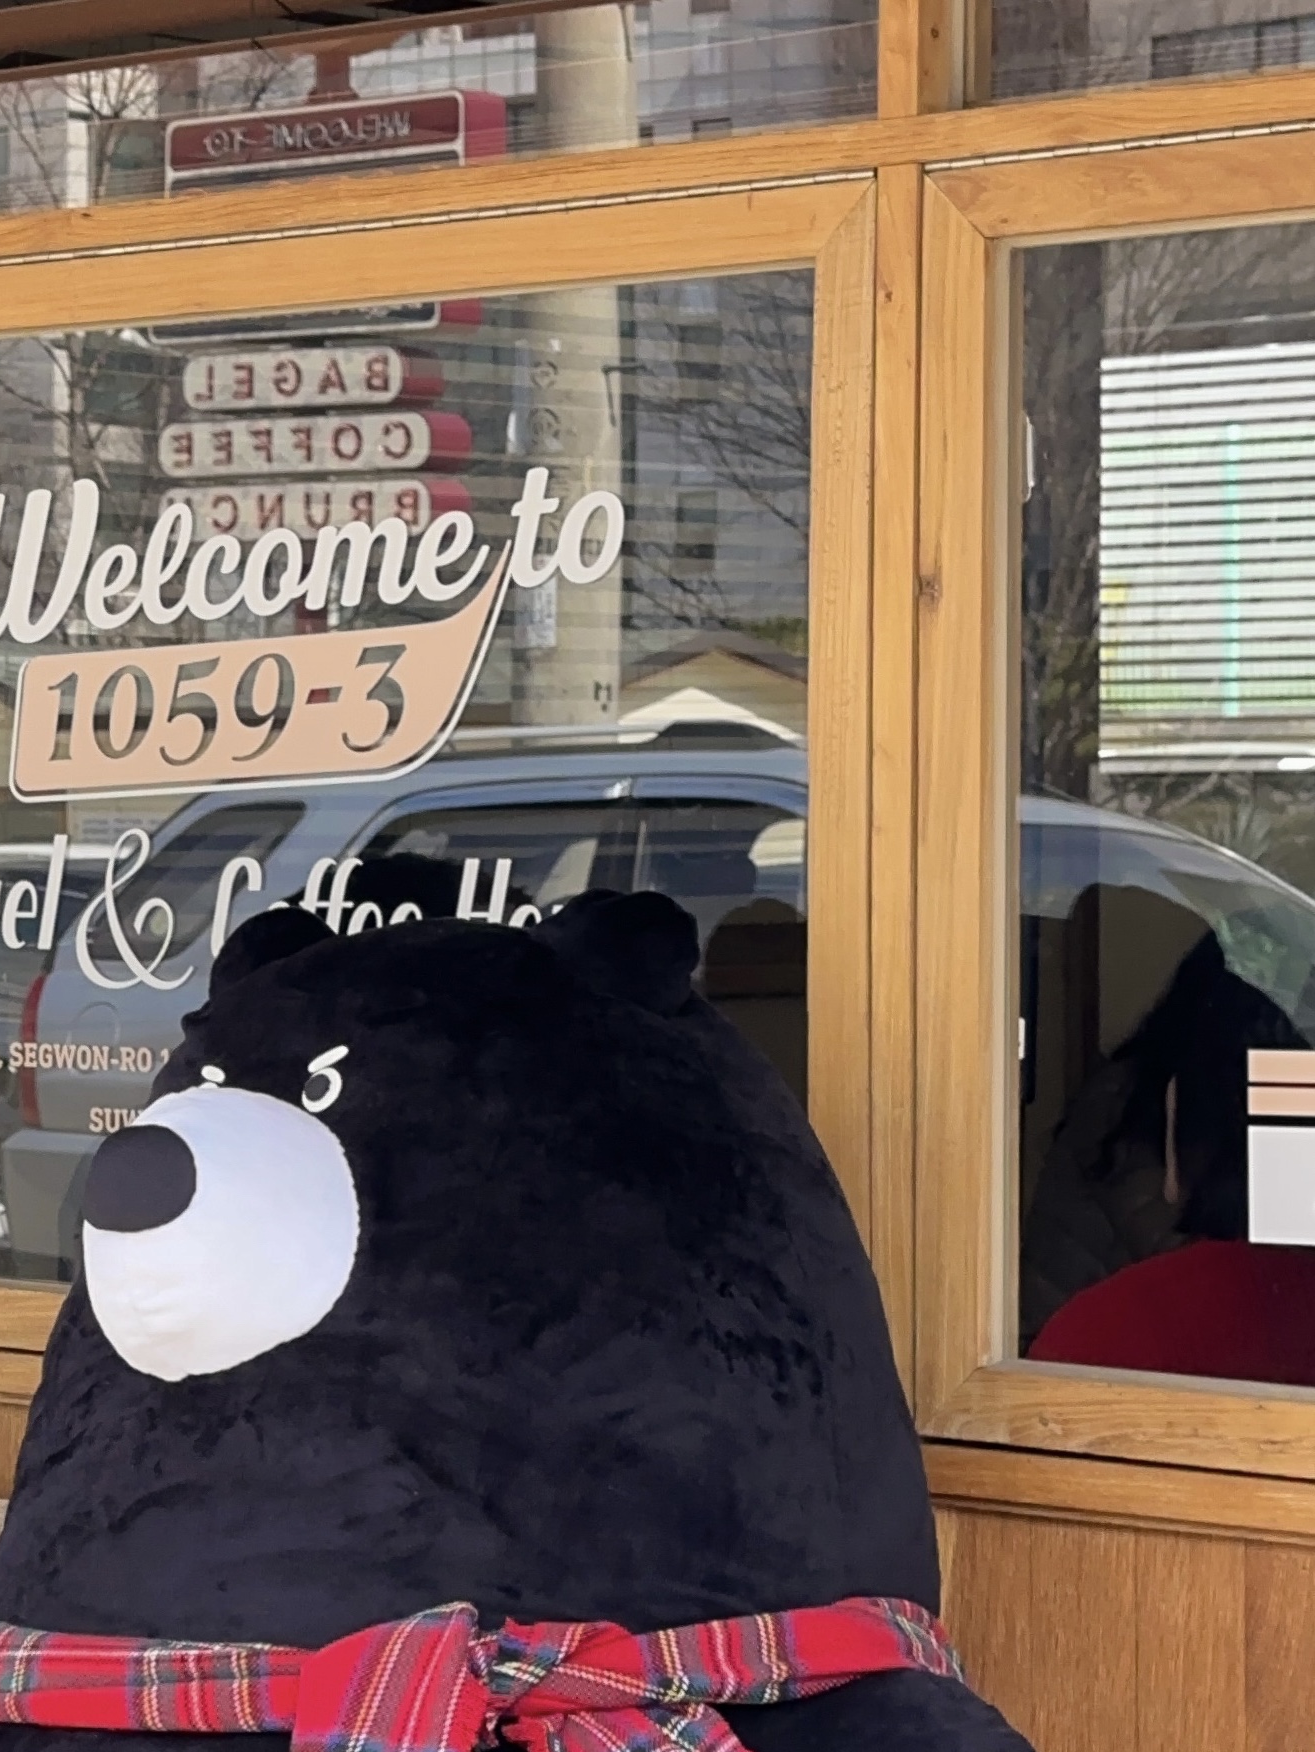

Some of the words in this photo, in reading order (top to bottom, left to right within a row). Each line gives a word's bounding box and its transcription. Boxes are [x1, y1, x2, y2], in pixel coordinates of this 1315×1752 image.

[509, 466, 625, 588] to
[46, 643, 408, 767] 1059-3
[76, 828, 194, 989] &
[211, 857, 423, 957] Cff
[9, 1042, 153, 1073] SEGWON-RO
